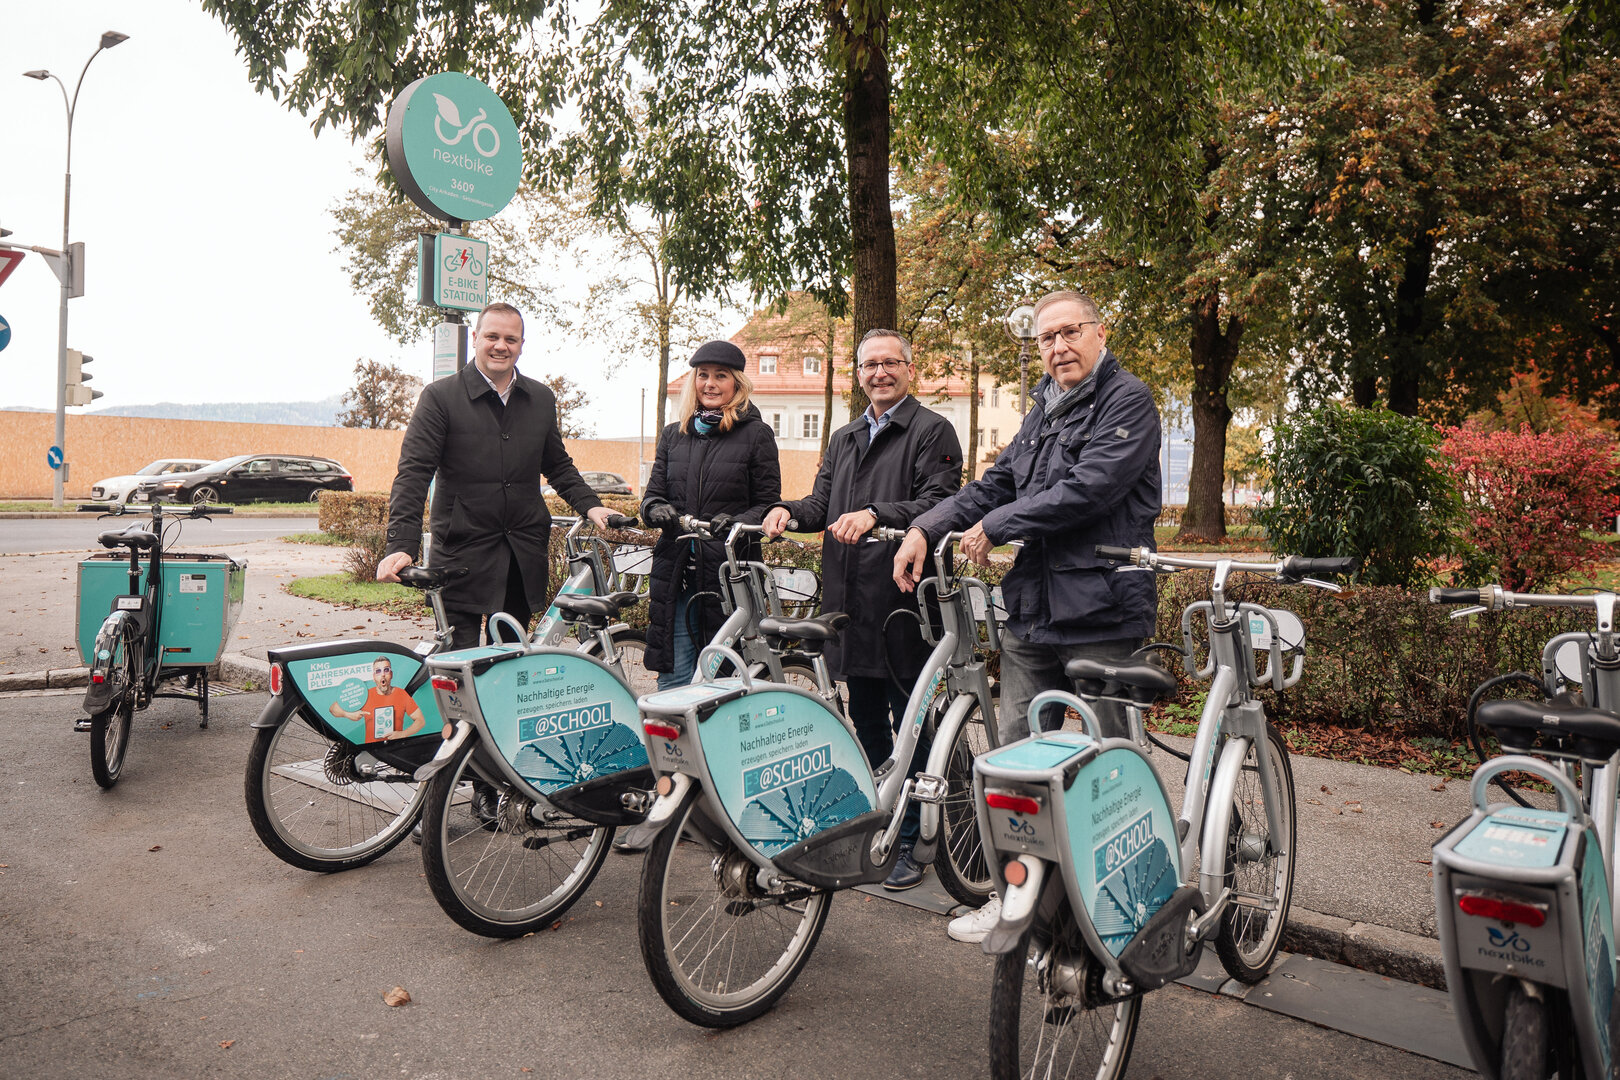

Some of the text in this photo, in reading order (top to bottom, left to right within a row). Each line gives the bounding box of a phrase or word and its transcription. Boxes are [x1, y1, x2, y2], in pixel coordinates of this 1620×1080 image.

[433, 148, 494, 176] nextbike
[450, 178, 475, 193] 3609
[448, 276, 478, 290] E-BIKE
[443, 288, 483, 304] STATION
[310, 666, 372, 680] JAHRESKARTE
[311, 663, 330, 671] KMG
[311, 679, 332, 688] PLUS
[516, 682, 595, 704] Nachhaltige Energie
[573, 696, 588, 704] laden
[740, 722, 814, 752] Nachhaltige Energie
[794, 740, 809, 749] laden
[1092, 799, 1123, 826] Nachhaltige
[1124, 785, 1142, 806] Energie
[1004, 832, 1045, 846] nextbike
[1478, 947, 1547, 968] nextbike
